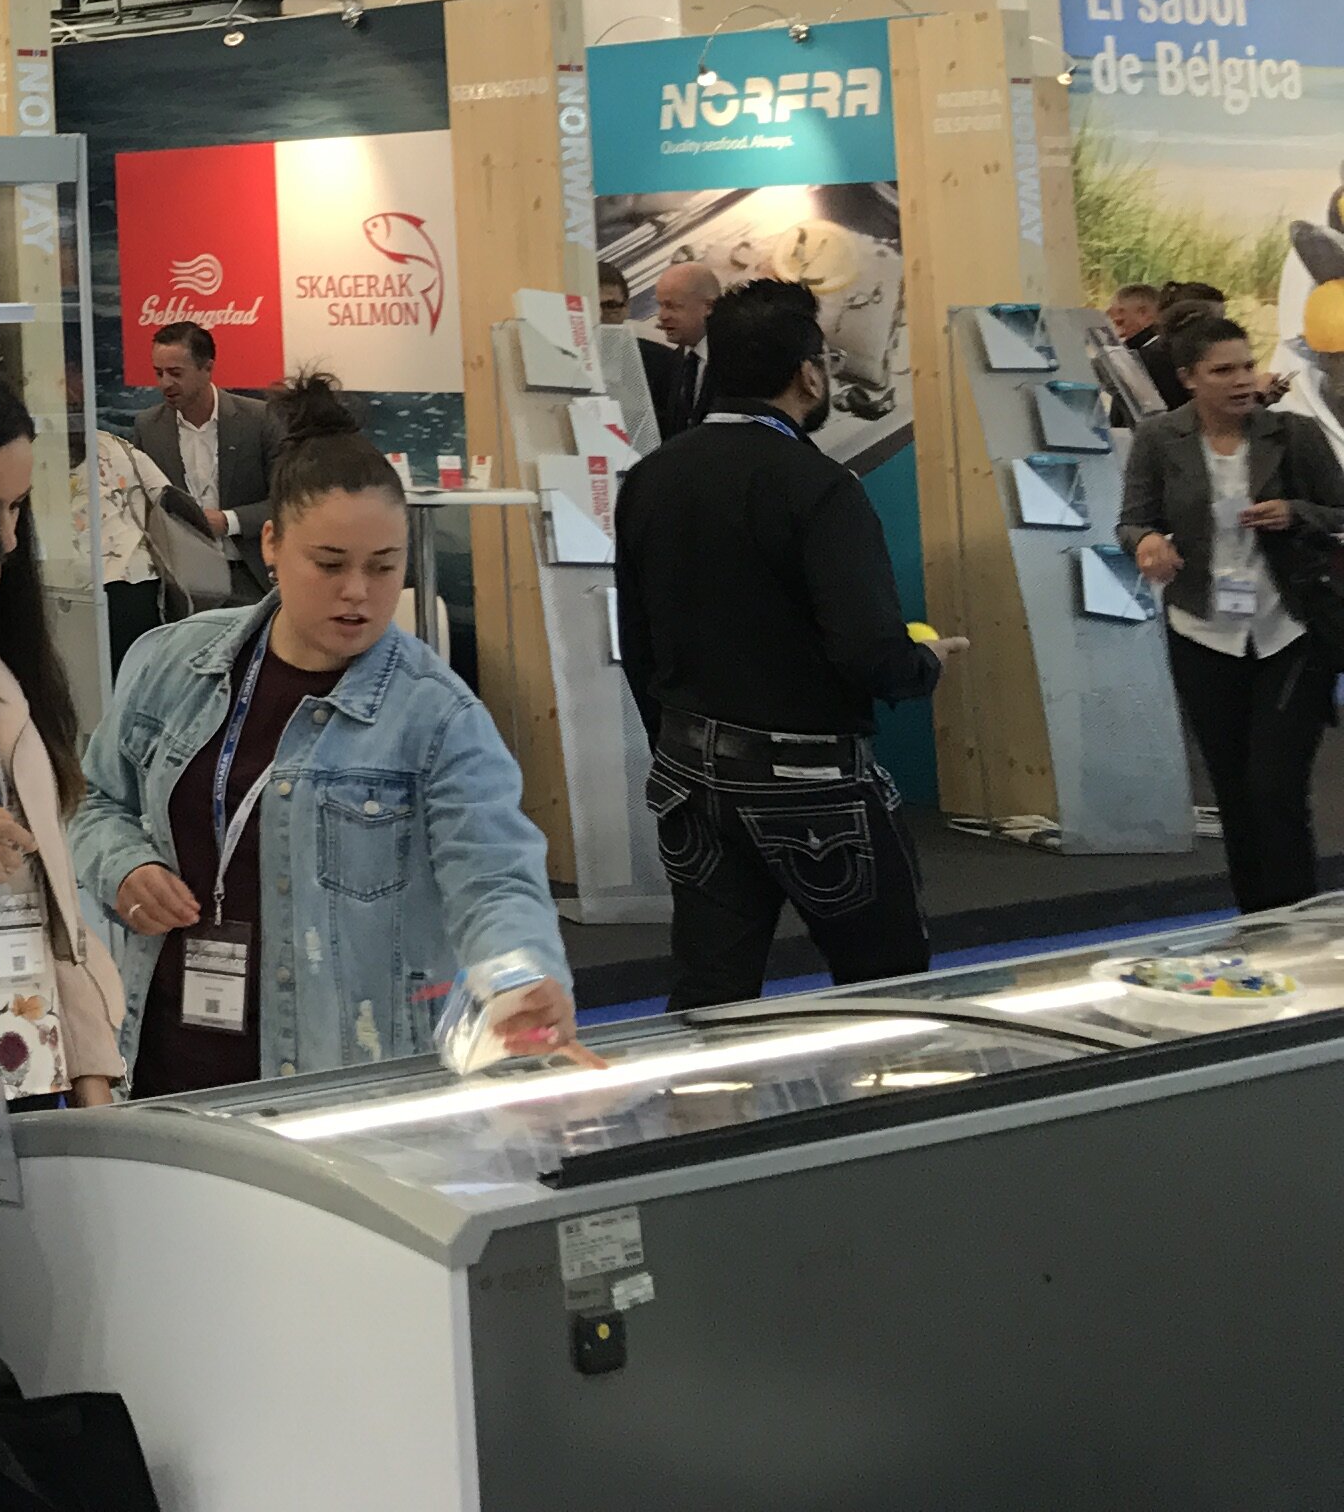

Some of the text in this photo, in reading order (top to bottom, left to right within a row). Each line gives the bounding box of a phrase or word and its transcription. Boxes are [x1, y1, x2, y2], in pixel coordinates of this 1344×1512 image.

[659, 67, 883, 131] NORFRA
[1091, 34, 1303, 116] de Bélgica
[16, 62, 55, 255] NOAY
[558, 76, 597, 250] NORWAY
[295, 273, 415, 300] SKAGERAK
[327, 301, 421, 327] SALMON
